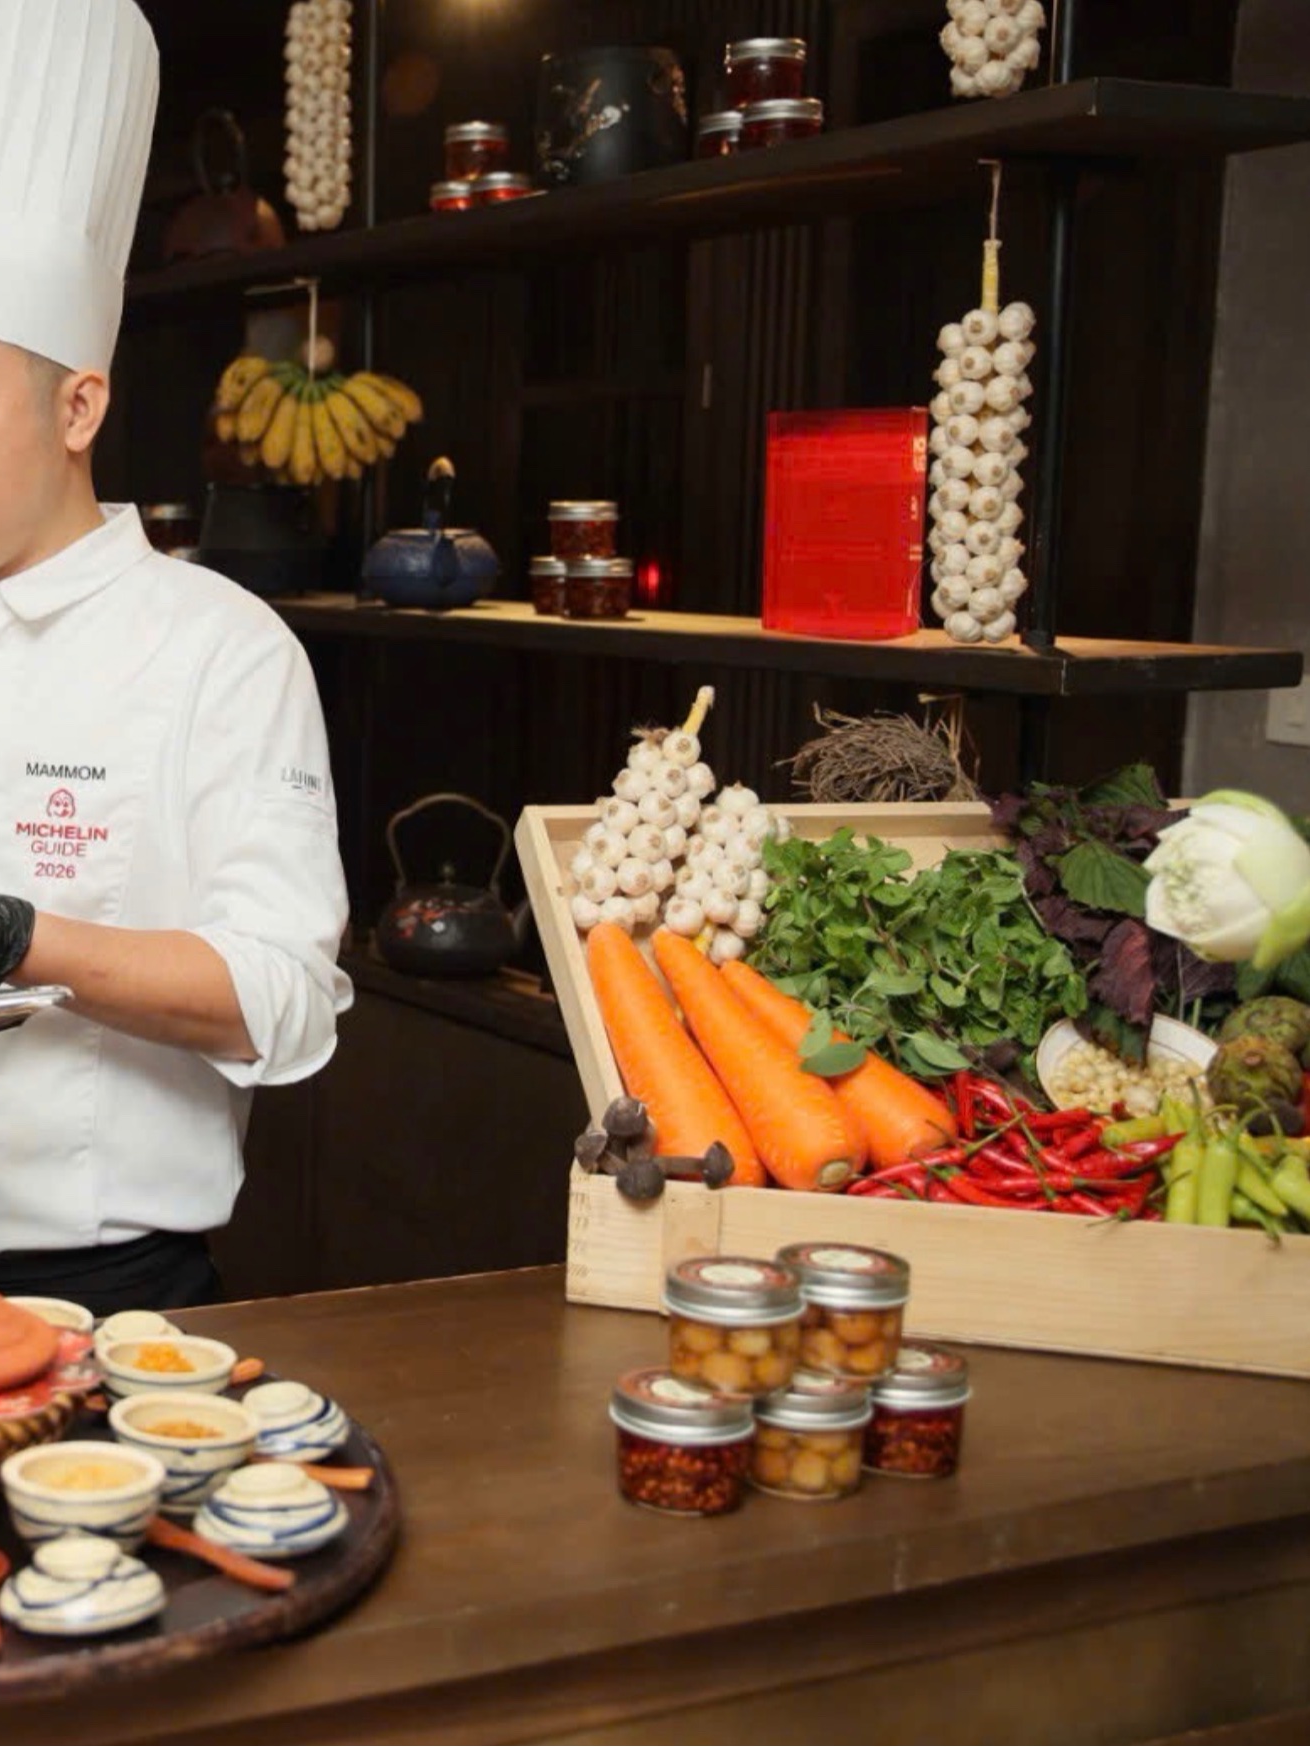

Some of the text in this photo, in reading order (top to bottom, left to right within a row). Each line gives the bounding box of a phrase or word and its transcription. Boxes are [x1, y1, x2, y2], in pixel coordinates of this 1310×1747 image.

[26, 762, 106, 780] MAMMOM
[15, 822, 108, 841] MICHELIN
[31, 840, 87, 857] GUIDE
[35, 862, 76, 879] 2026
